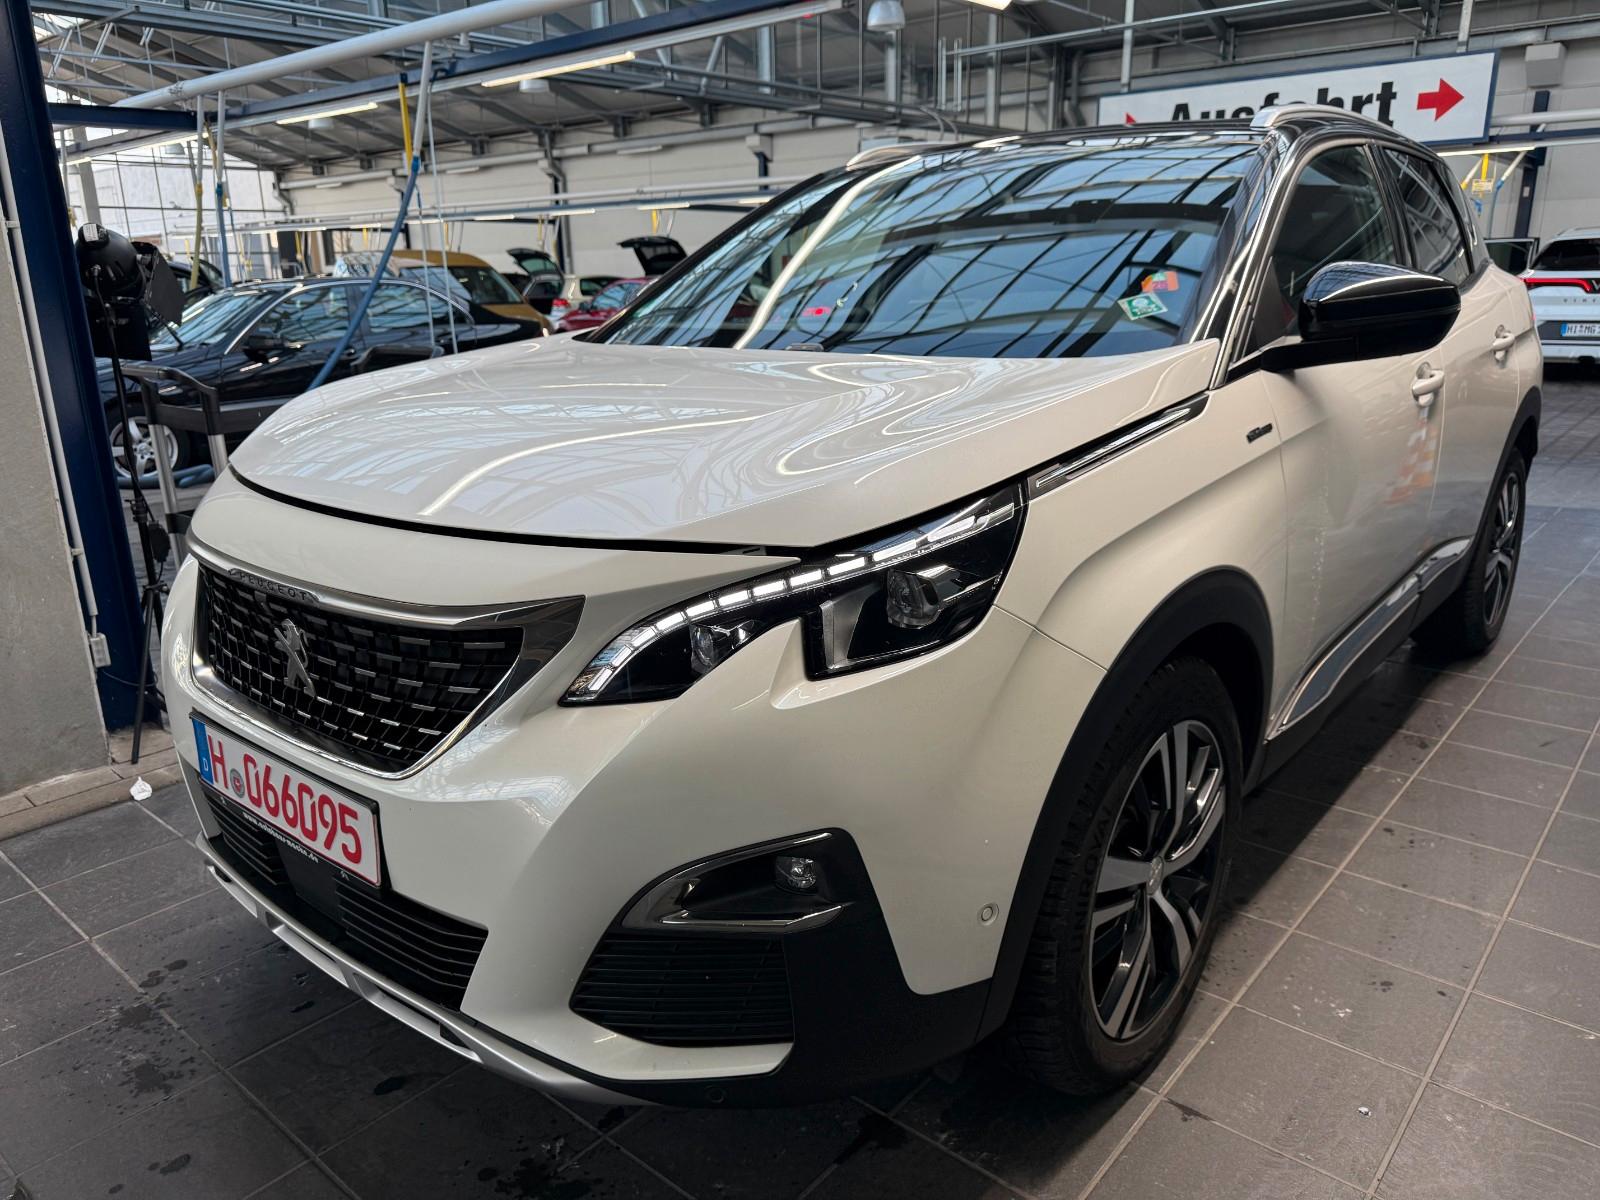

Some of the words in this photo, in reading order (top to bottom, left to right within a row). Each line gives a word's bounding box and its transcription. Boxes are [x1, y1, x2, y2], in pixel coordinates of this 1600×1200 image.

[240, 573, 307, 600] PEUGEOT
[208, 734, 229, 790] H
[243, 753, 362, 864] 066095
